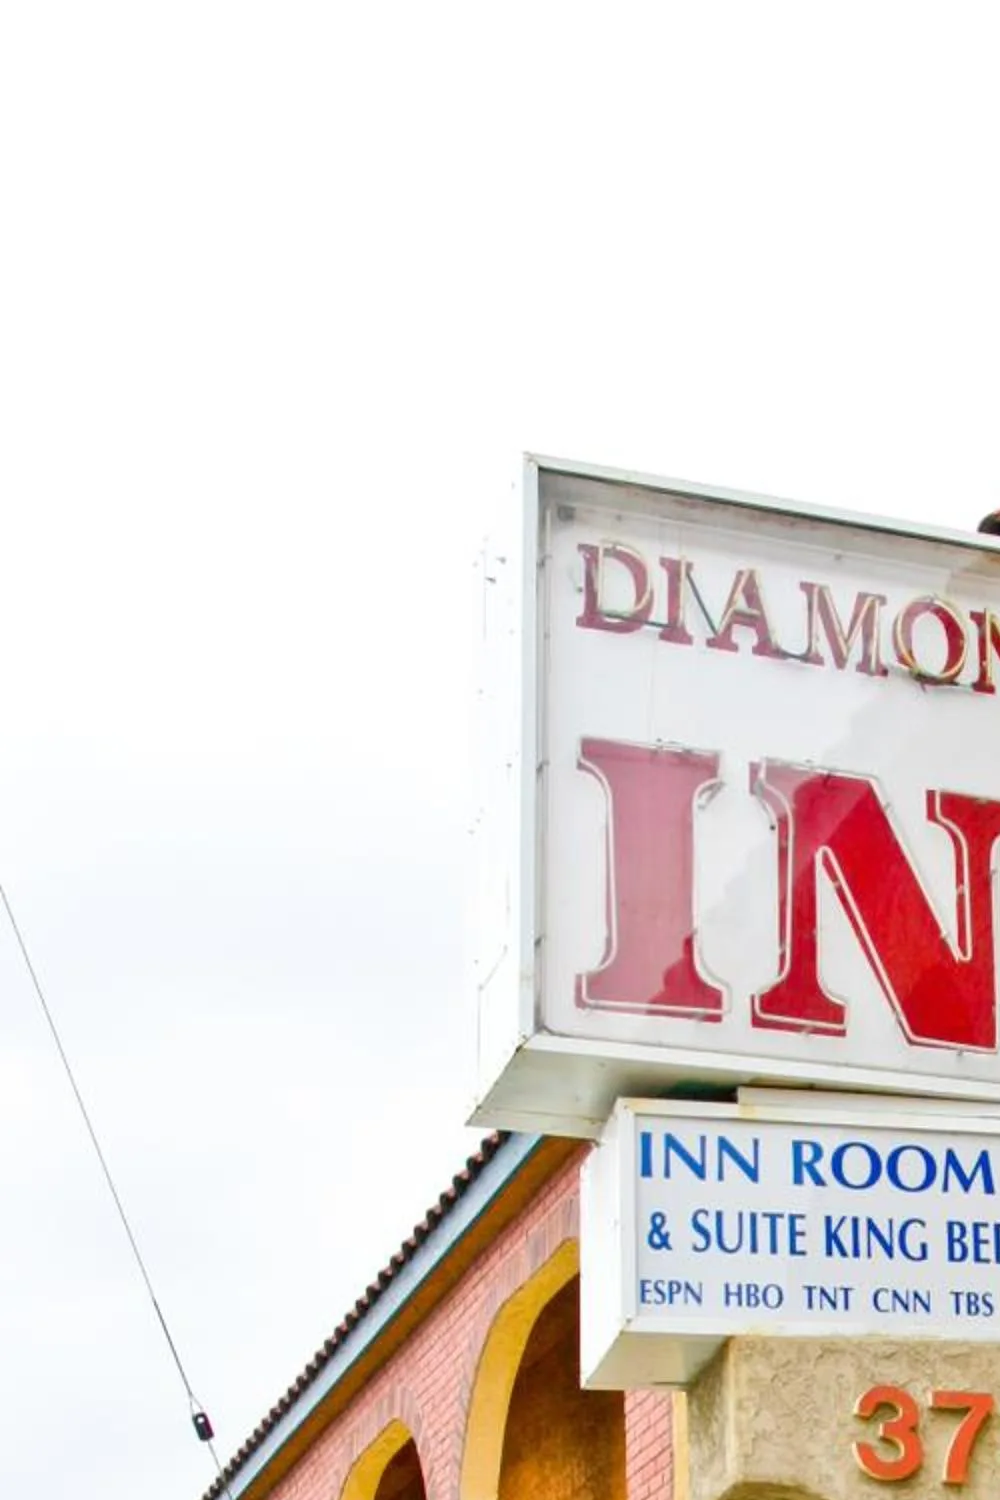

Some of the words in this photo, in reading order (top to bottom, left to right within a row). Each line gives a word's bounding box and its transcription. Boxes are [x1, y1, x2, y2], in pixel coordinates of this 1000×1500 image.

[640, 1132, 760, 1183] INN
[791, 1140, 995, 1195] ROOM
[647, 1211, 673, 1251] &
[691, 1209, 808, 1257] SUITE
[824, 1215, 927, 1264] KING
[639, 1278, 703, 1306] ESPN
[723, 1282, 784, 1310] HBO
[802, 1285, 854, 1312] TNT
[872, 1287, 932, 1315] CNN
[950, 1291, 994, 1318] TBS
